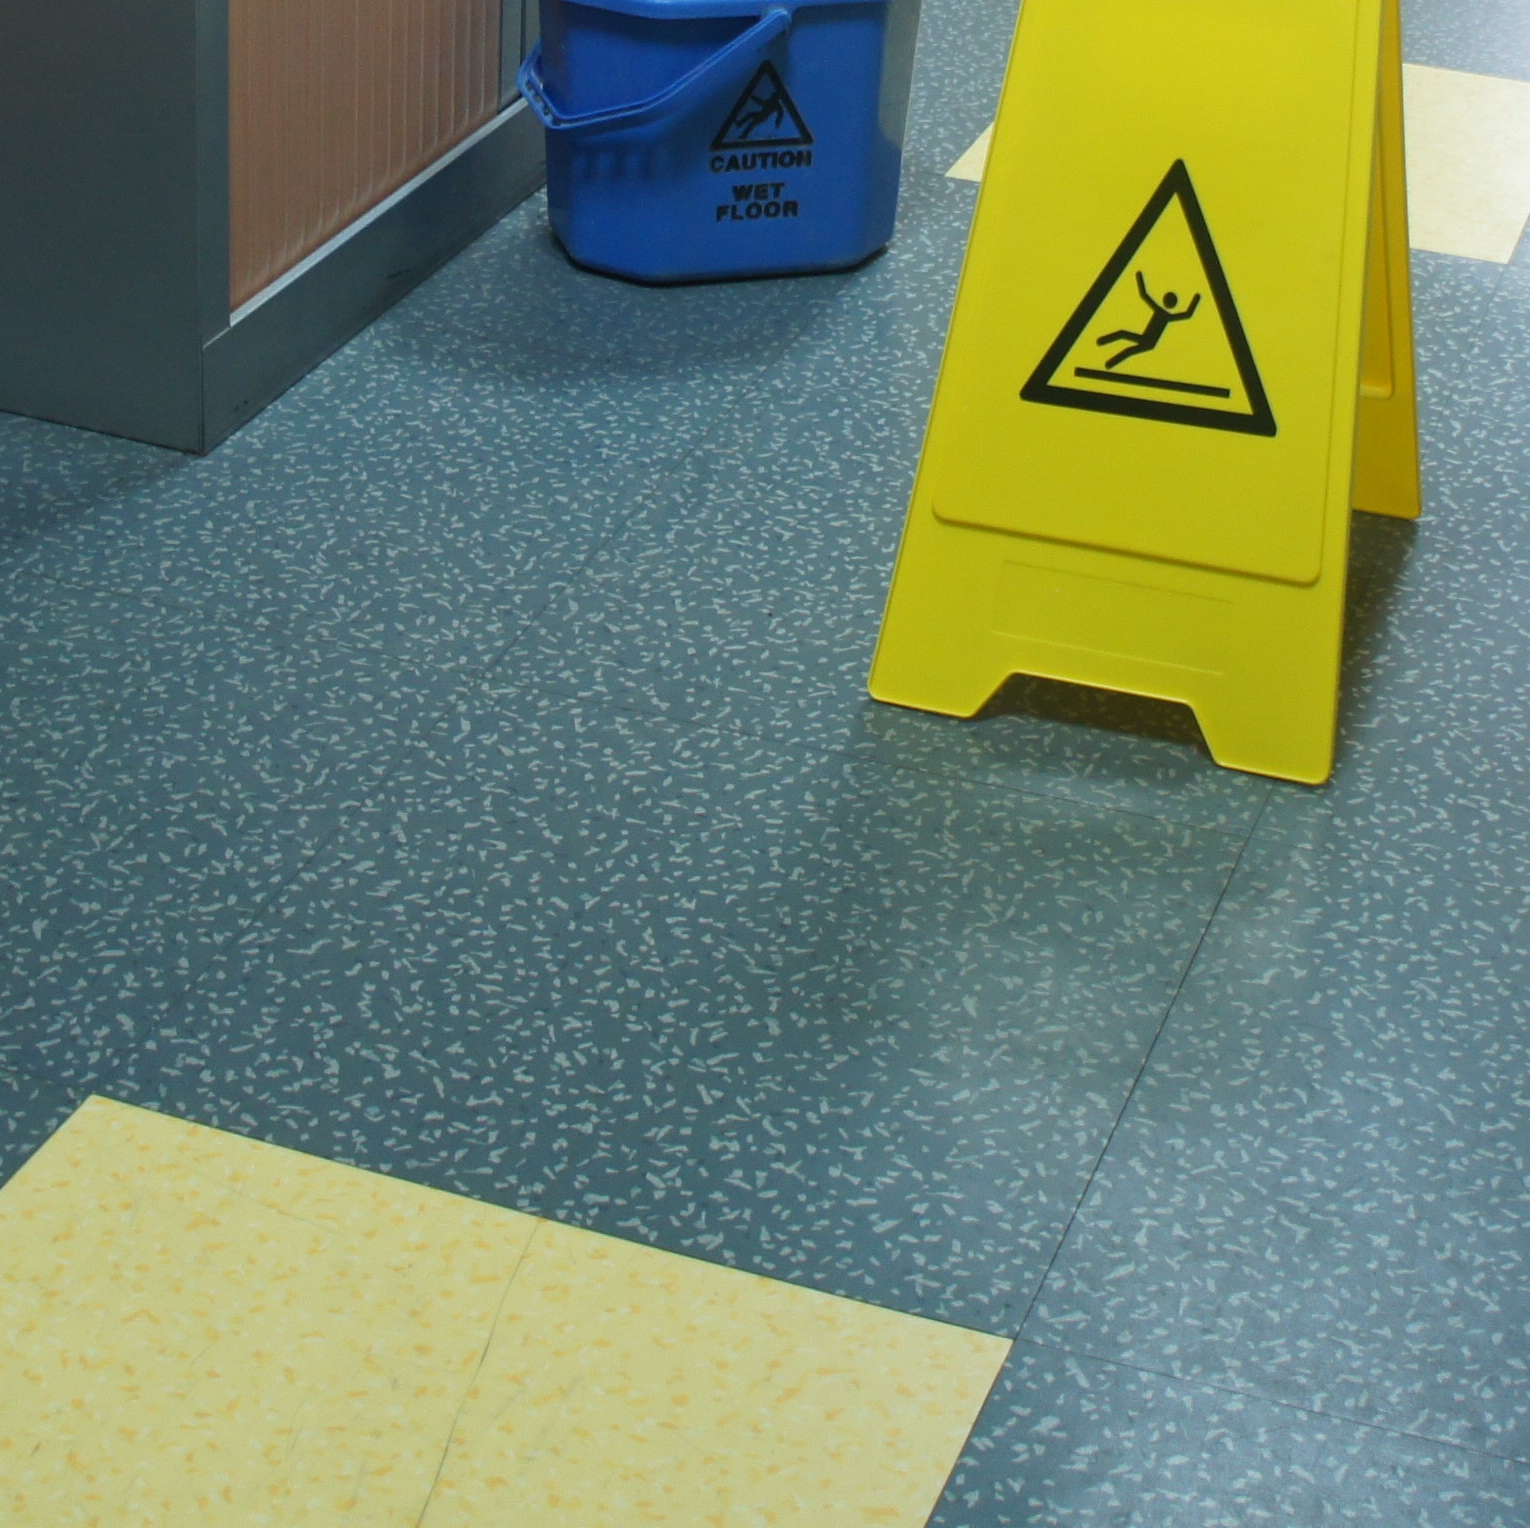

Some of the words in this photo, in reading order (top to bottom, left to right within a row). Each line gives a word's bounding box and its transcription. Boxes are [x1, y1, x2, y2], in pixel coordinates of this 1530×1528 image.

[710, 150, 813, 174] CAUTION
[732, 182, 786, 202] WET
[716, 200, 799, 223] FLOOR
